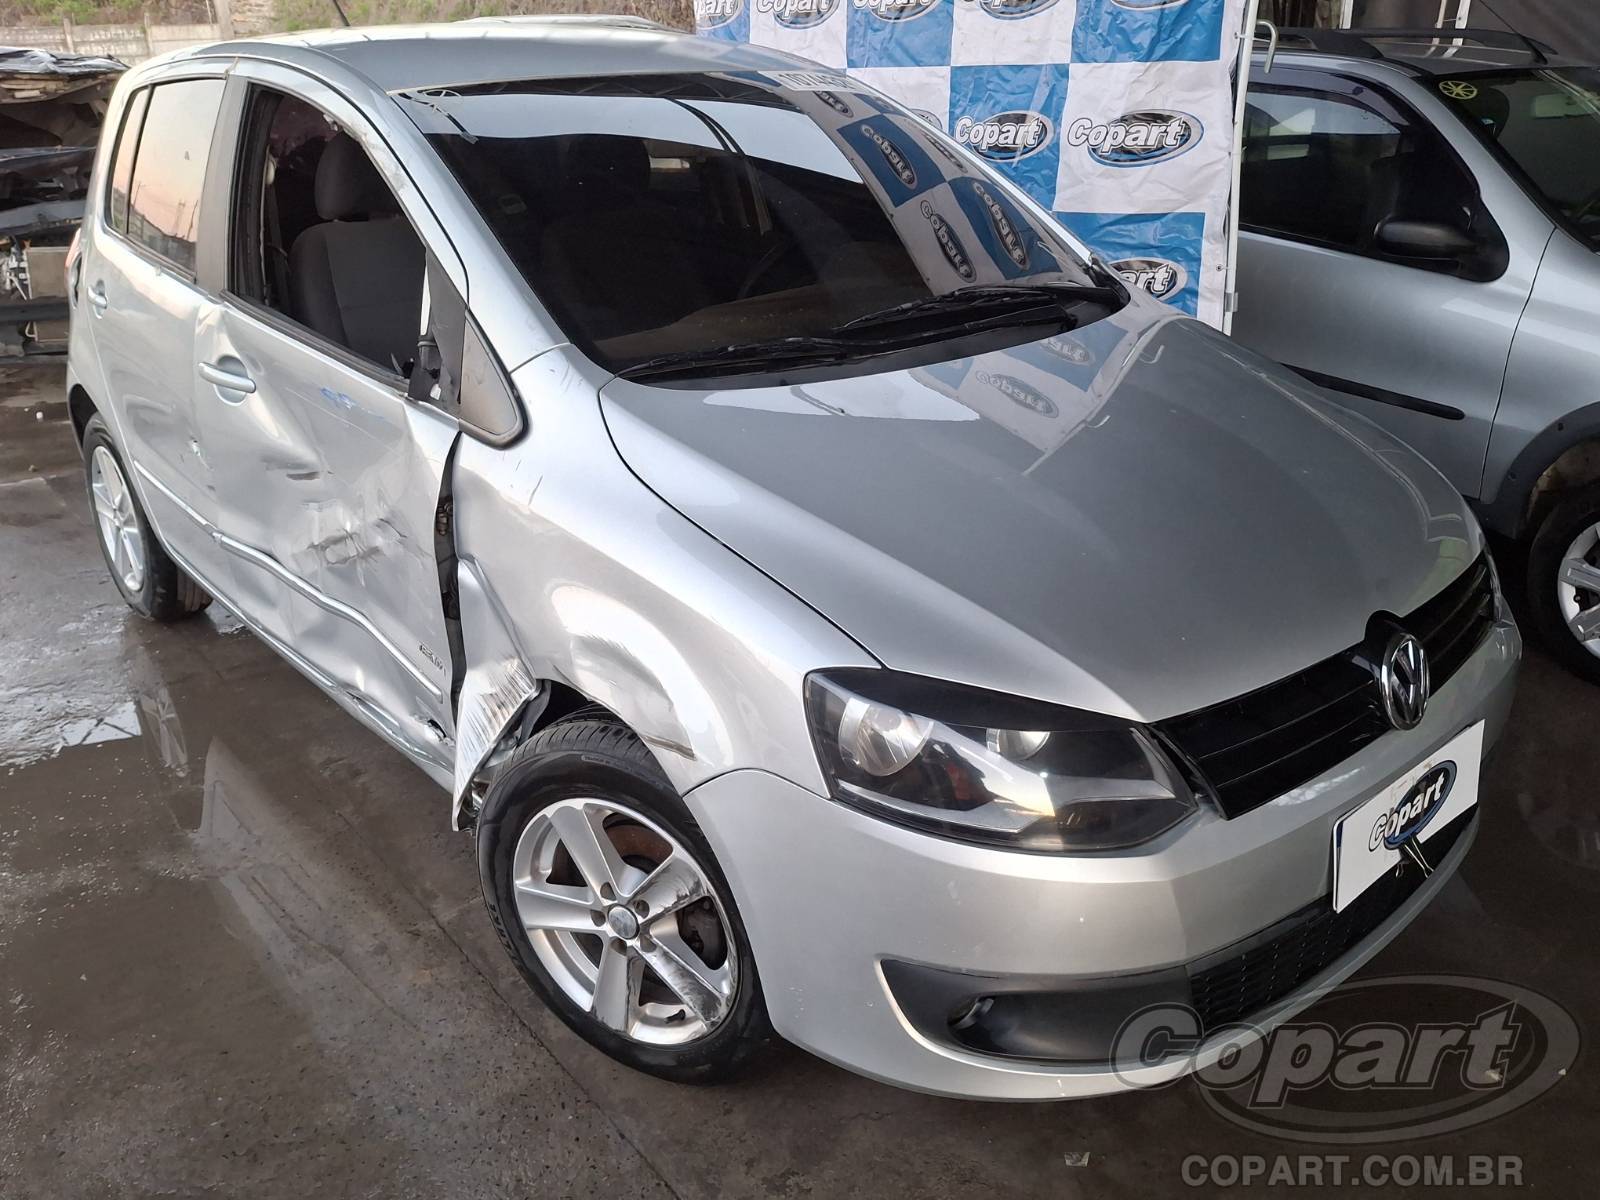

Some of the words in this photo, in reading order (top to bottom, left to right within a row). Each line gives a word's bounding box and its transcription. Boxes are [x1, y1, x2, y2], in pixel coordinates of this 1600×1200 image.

[955, 115, 1043, 152] Copart
[1067, 116, 1186, 155] Copart
[1368, 772, 1445, 852] Copart
